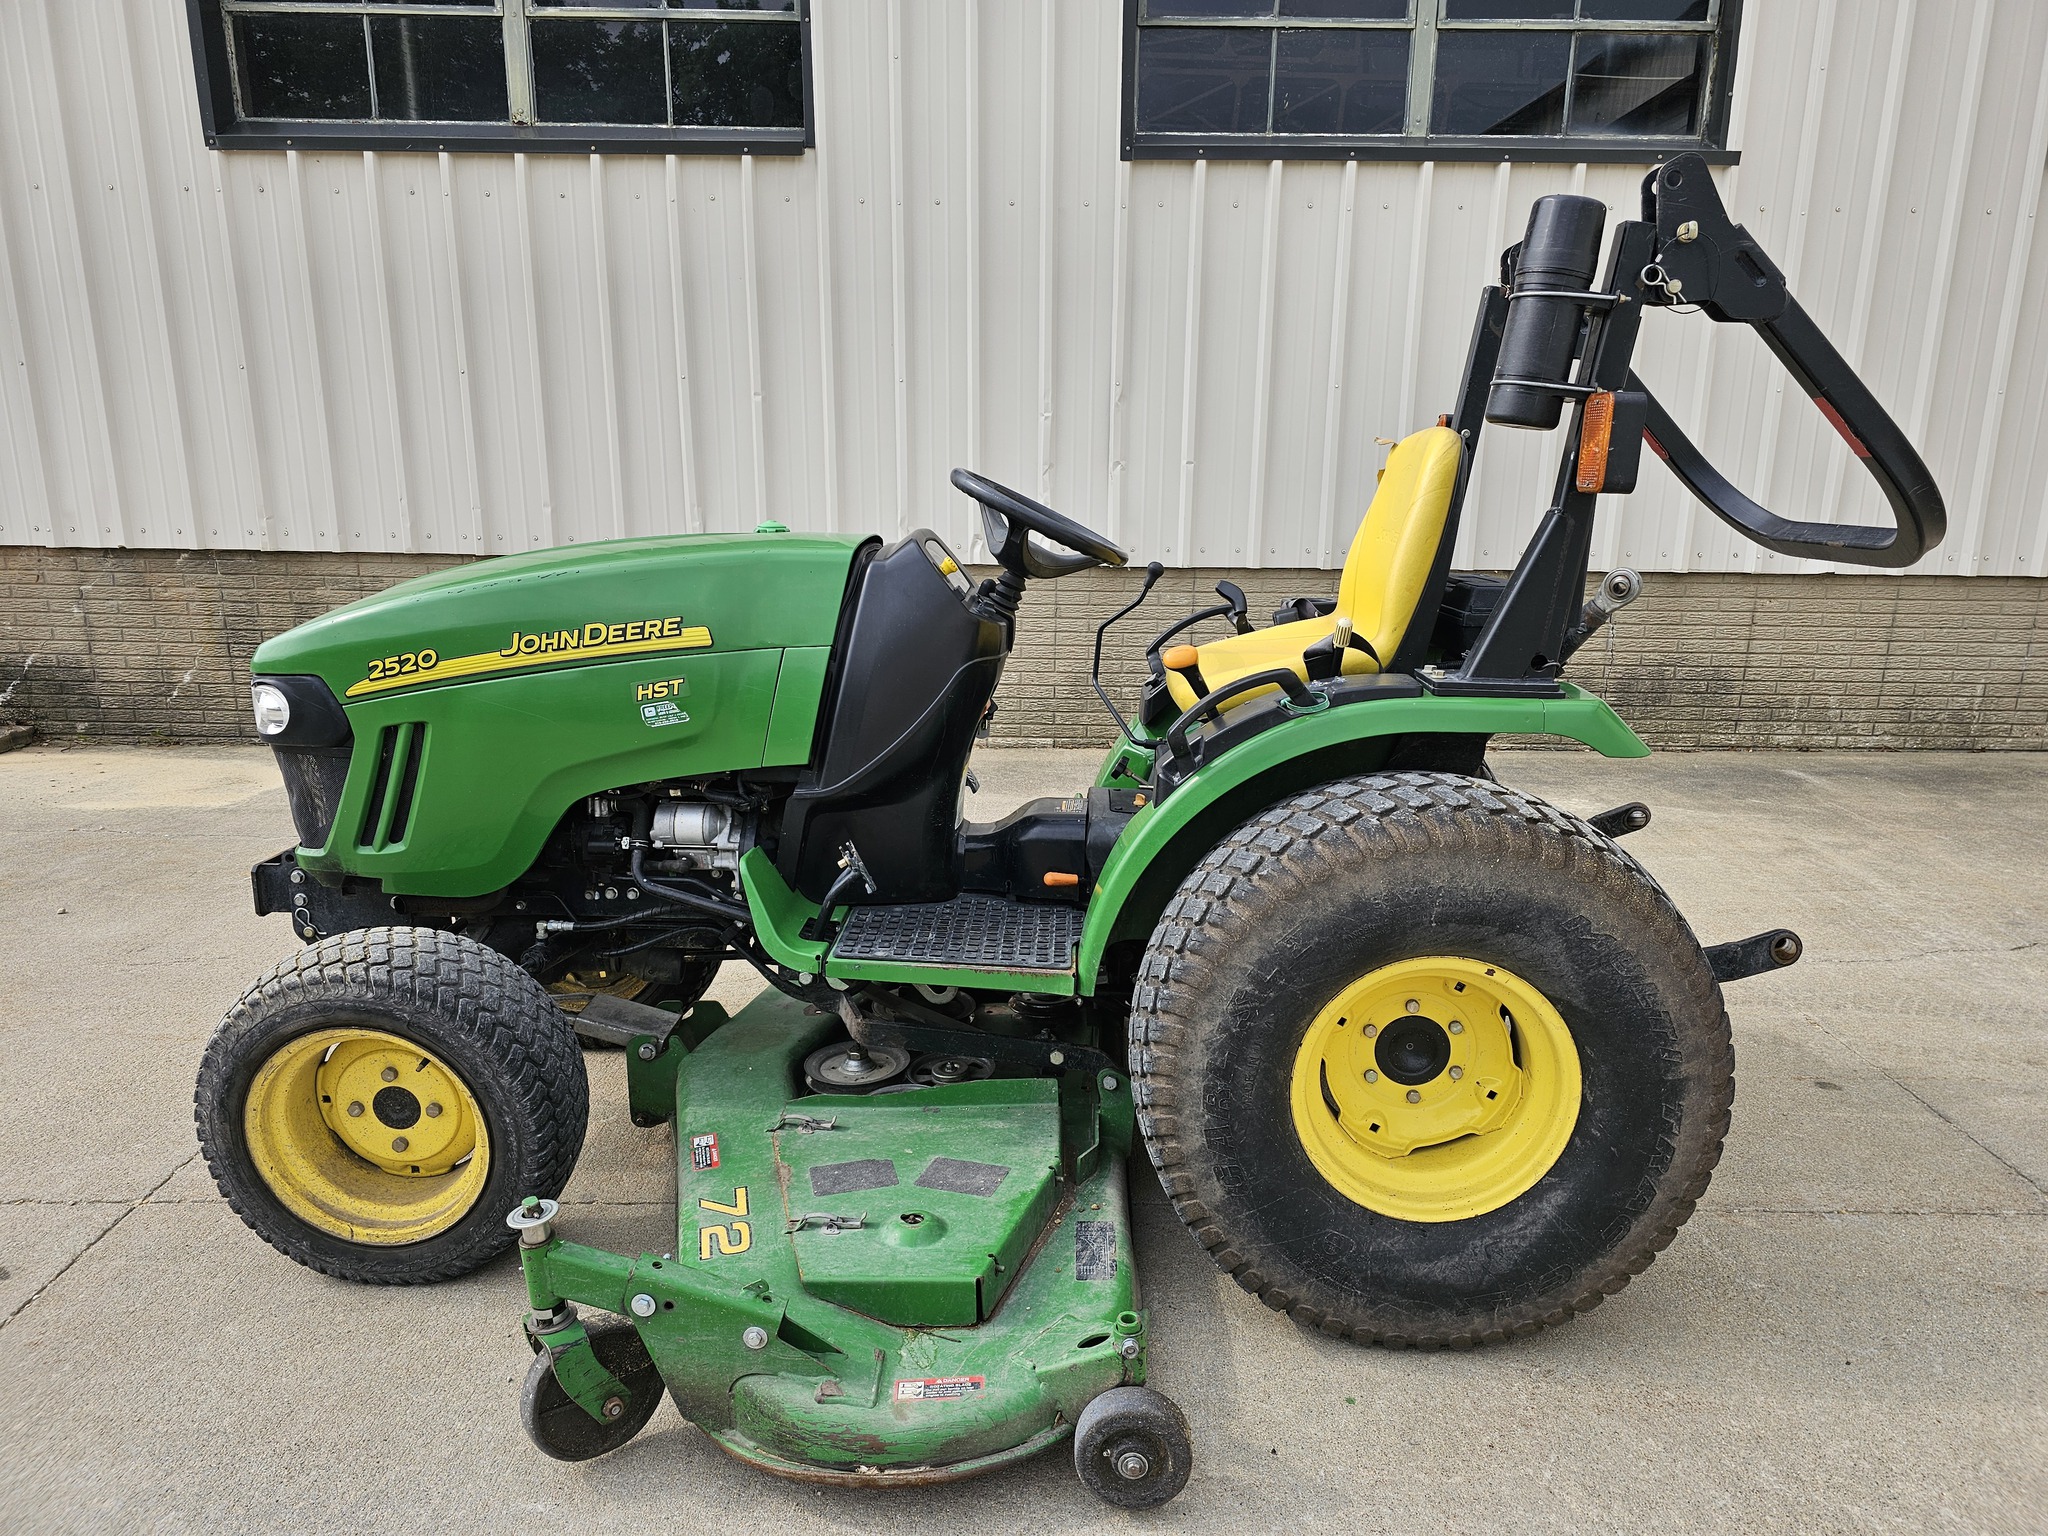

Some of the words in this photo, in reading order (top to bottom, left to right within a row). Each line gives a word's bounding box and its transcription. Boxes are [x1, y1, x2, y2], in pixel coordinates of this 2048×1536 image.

[368, 648, 439, 682] 2520
[636, 678, 685, 702] HST
[699, 1186, 752, 1260] 72
